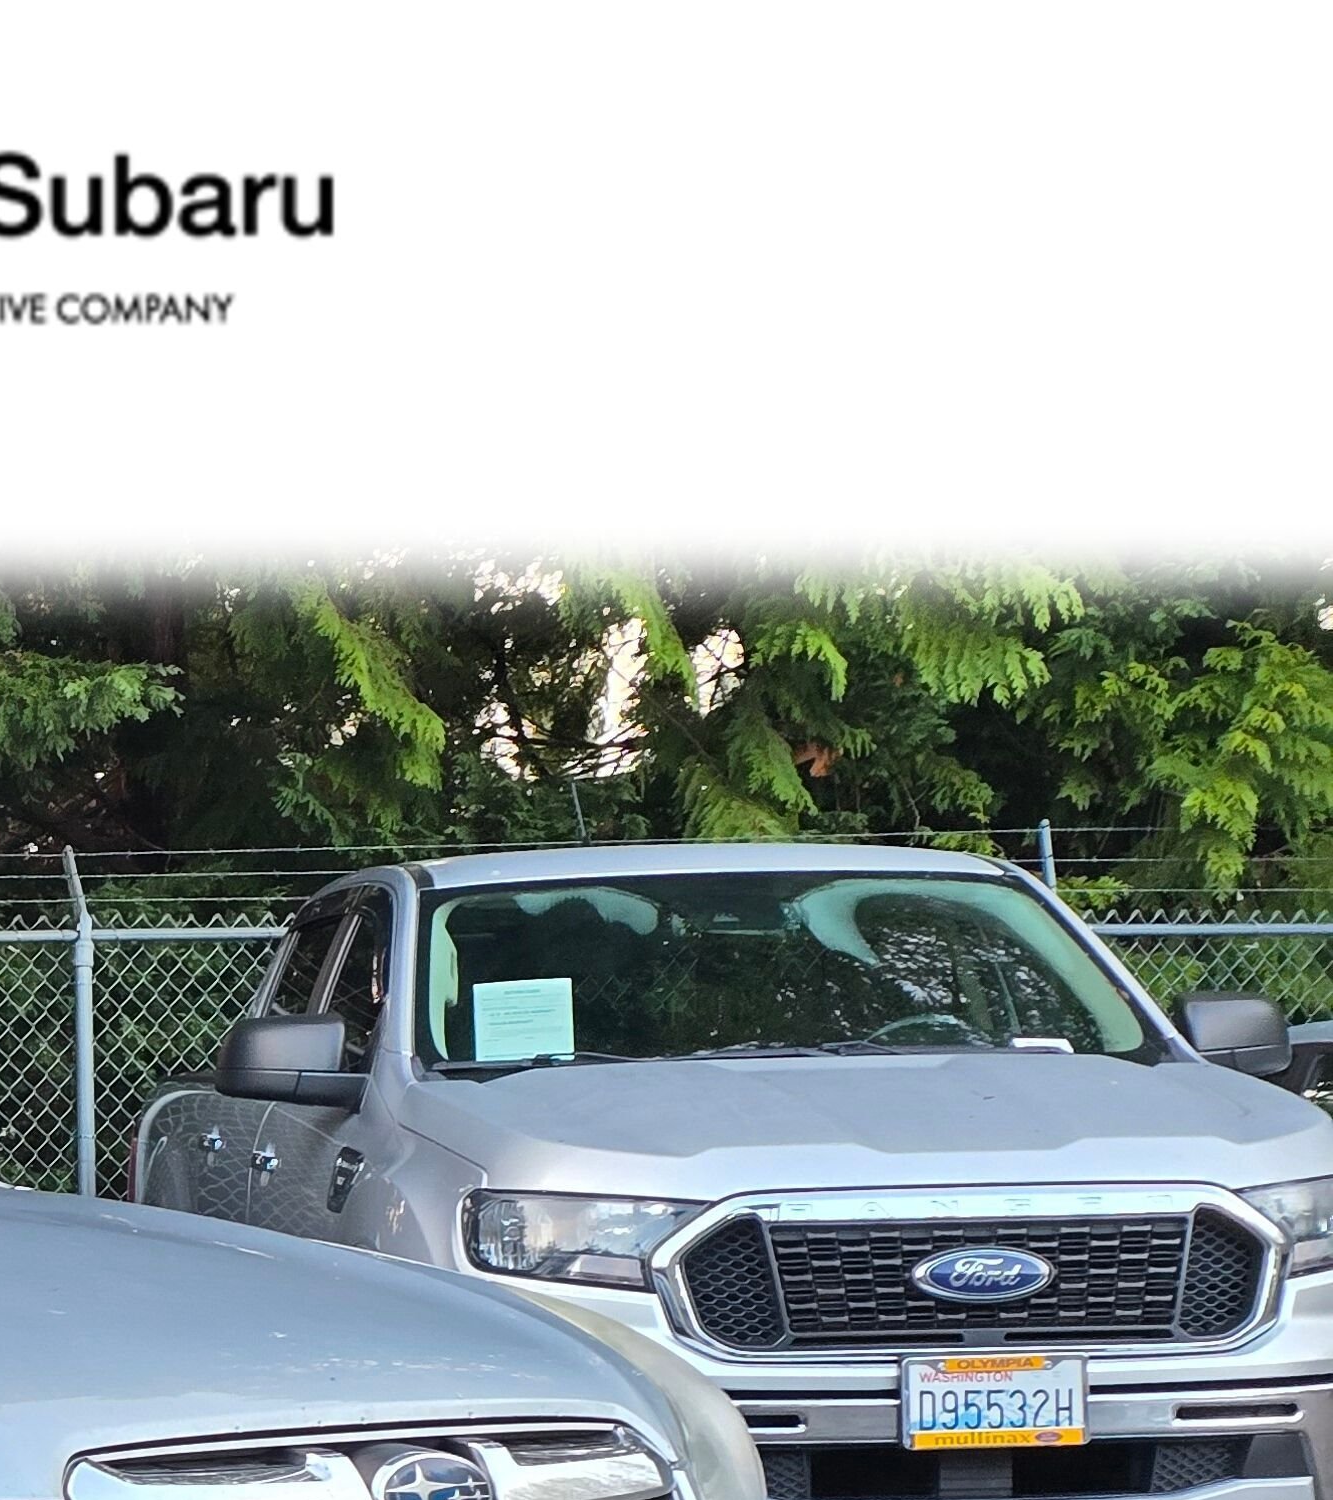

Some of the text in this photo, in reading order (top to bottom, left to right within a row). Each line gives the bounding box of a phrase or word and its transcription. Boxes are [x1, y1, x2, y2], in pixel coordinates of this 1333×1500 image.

[949, 1257, 1022, 1287] Ford
[957, 1357, 1035, 1370] OLYMPIA
[918, 1388, 1074, 1431] D95532H
